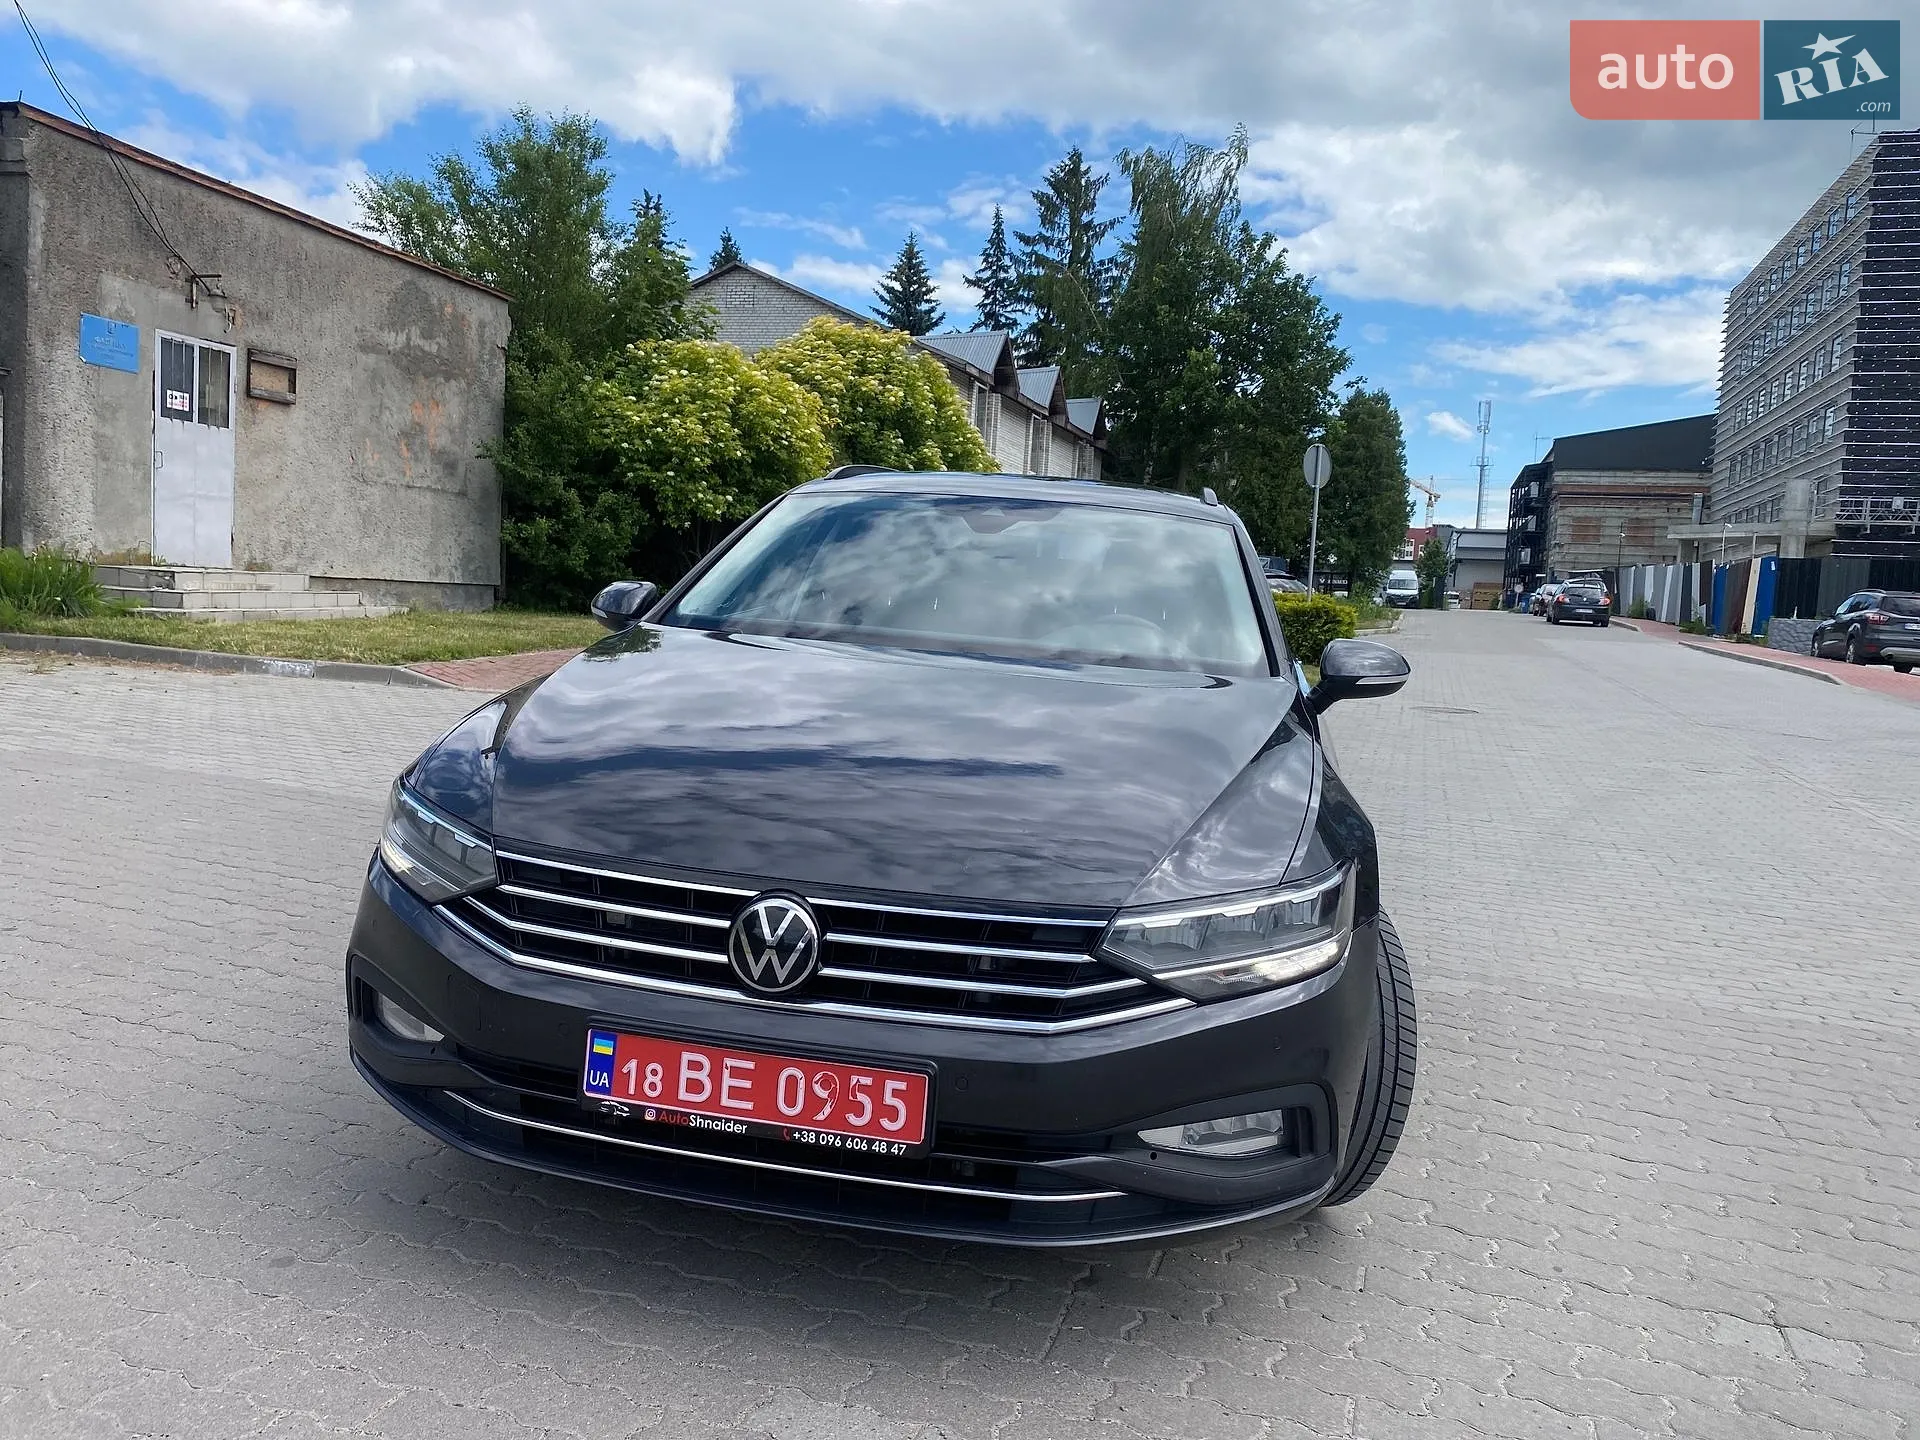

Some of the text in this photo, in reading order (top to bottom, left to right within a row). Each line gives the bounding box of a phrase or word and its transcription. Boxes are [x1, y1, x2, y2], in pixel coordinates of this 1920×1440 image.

[589, 1069, 610, 1088] UA
[621, 1051, 908, 1132] 18 BE 0955
[658, 1110, 748, 1134] AutoShnaider
[792, 1130, 907, 1156] +38 096 606 48 47
